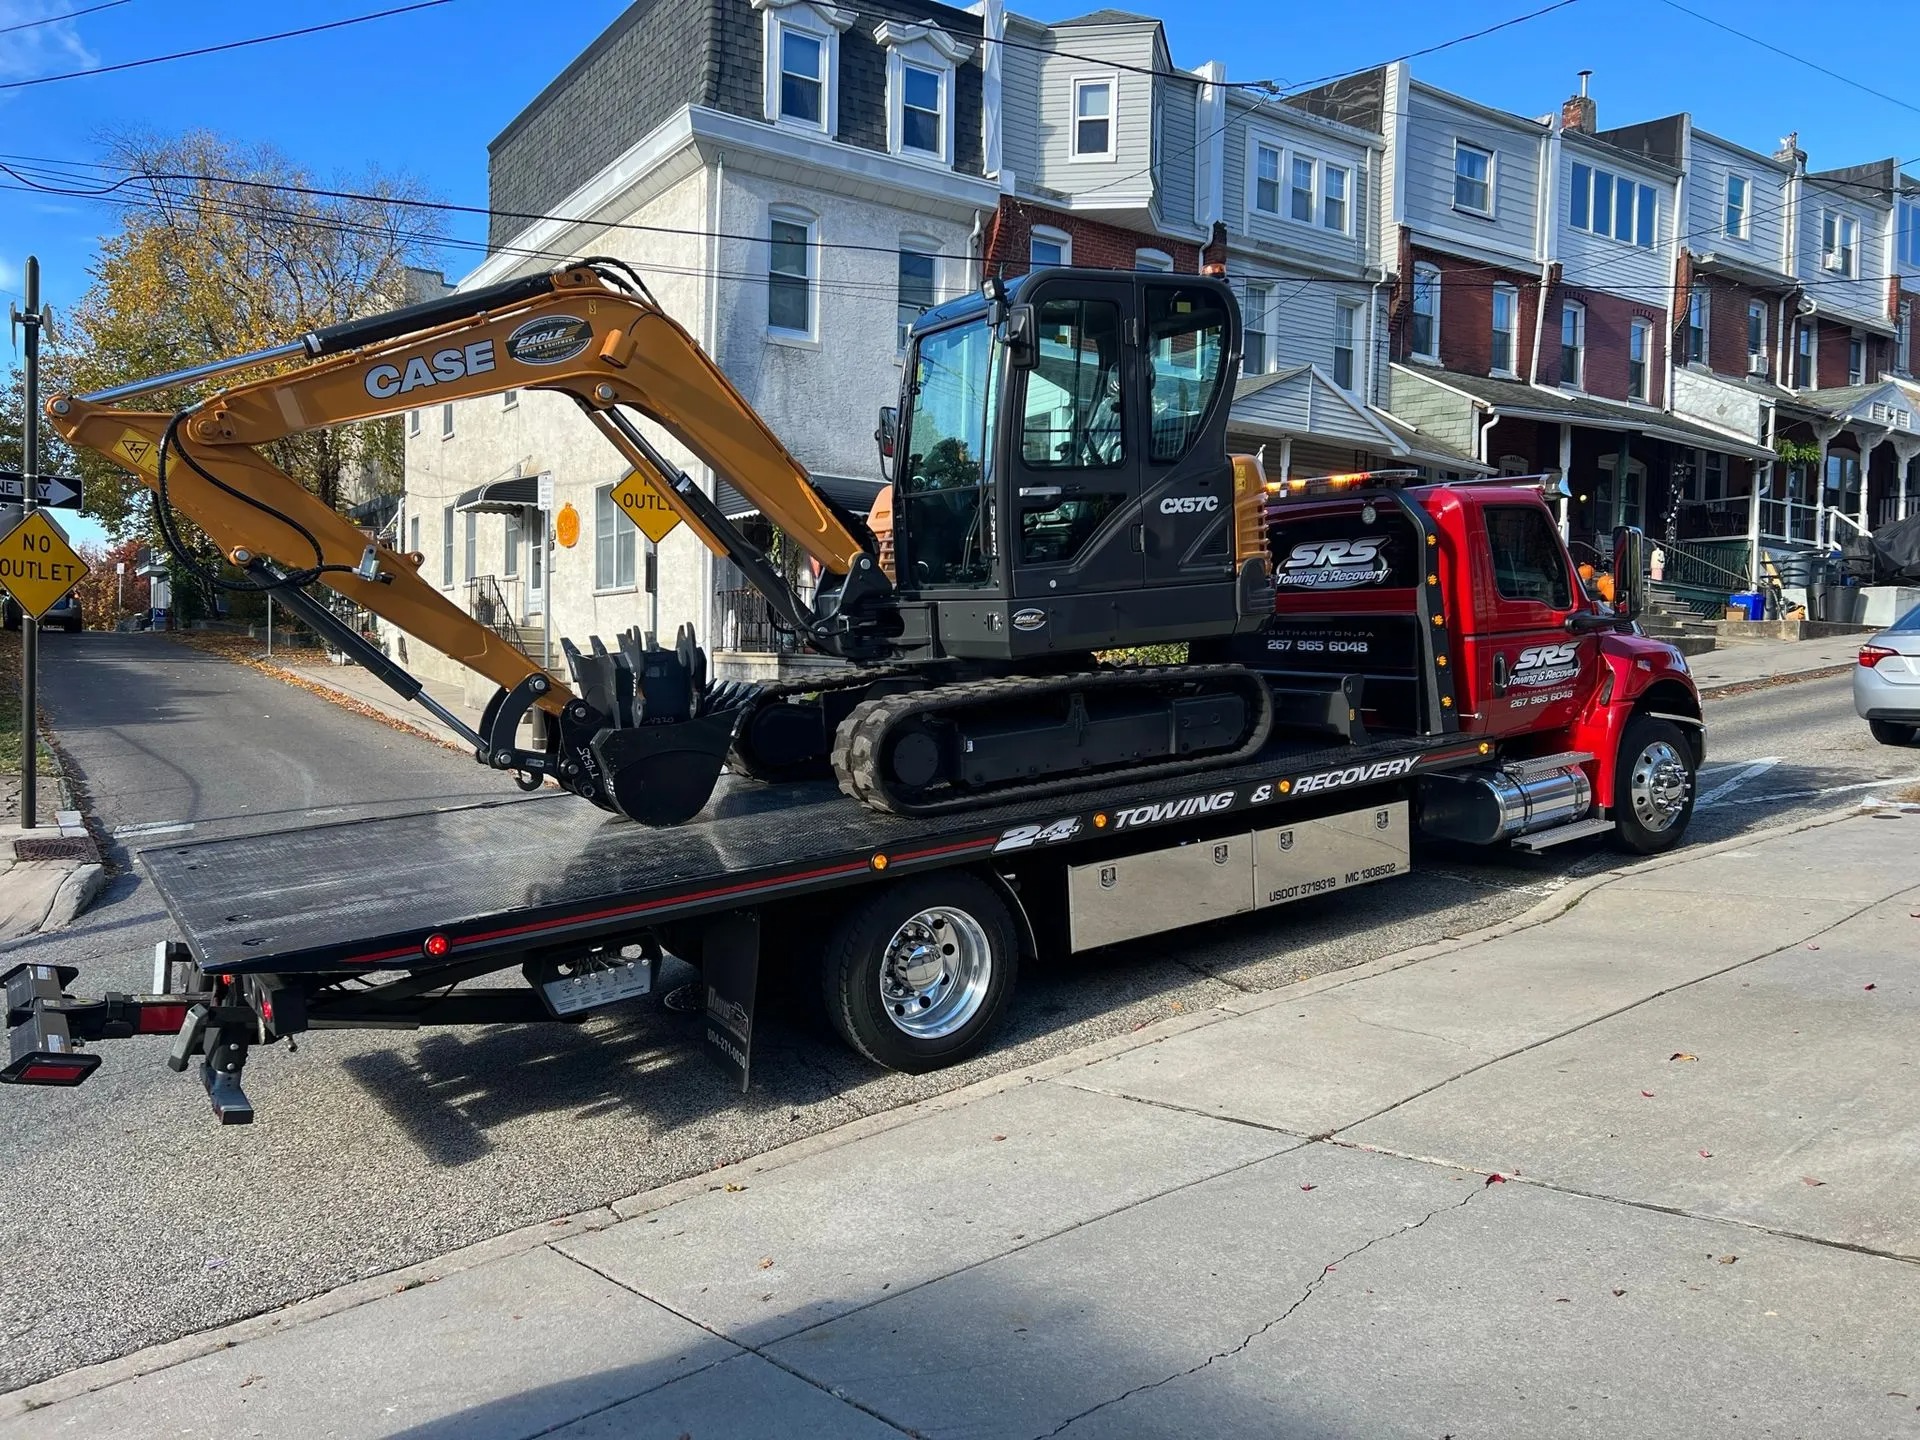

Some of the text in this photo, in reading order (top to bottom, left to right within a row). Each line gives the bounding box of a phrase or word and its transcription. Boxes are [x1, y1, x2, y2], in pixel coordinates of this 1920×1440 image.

[516, 328, 567, 348] EAGLE
[544, 337, 576, 349] EQUIPMENT
[364, 339, 496, 399] CASE
[623, 492, 674, 511] OUTL
[1160, 495, 1219, 514] CX57C
[23, 533, 51, 553] NO
[1284, 537, 1389, 568] SRS
[0, 558, 75, 582] OUTLET
[1277, 569, 1390, 586] Towing & Recovery
[1267, 639, 1368, 652] 267 965 6048
[1514, 641, 1581, 670] SRS
[1508, 668, 1582, 686] Towing & Recovery
[1510, 690, 1573, 708] 267 965 6048
[1115, 755, 1422, 829] TOWING & RECOVERY
[993, 817, 1079, 852] 24
[1269, 862, 1396, 902] USDOT 3719319 MC 1308502
